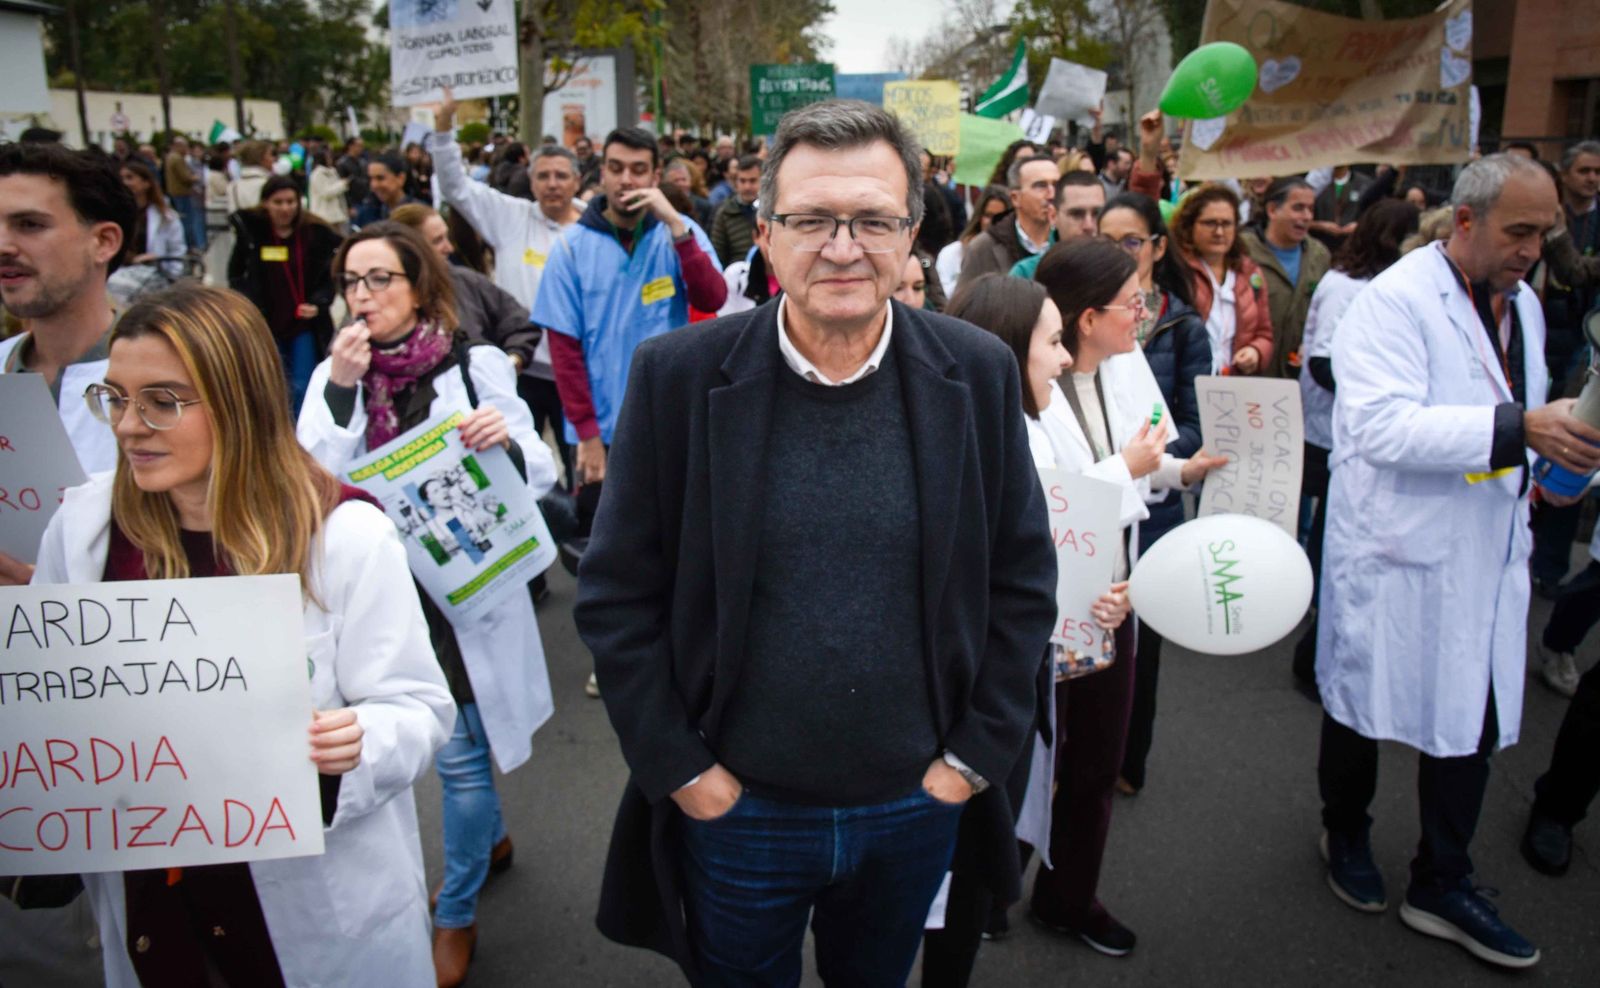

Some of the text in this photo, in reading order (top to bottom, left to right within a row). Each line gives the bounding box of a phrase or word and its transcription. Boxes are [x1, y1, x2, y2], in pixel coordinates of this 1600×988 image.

[458, 24, 513, 42] LABORAL
[1245, 402, 1264, 430] NO
[0, 796, 296, 851] COTIZADA
